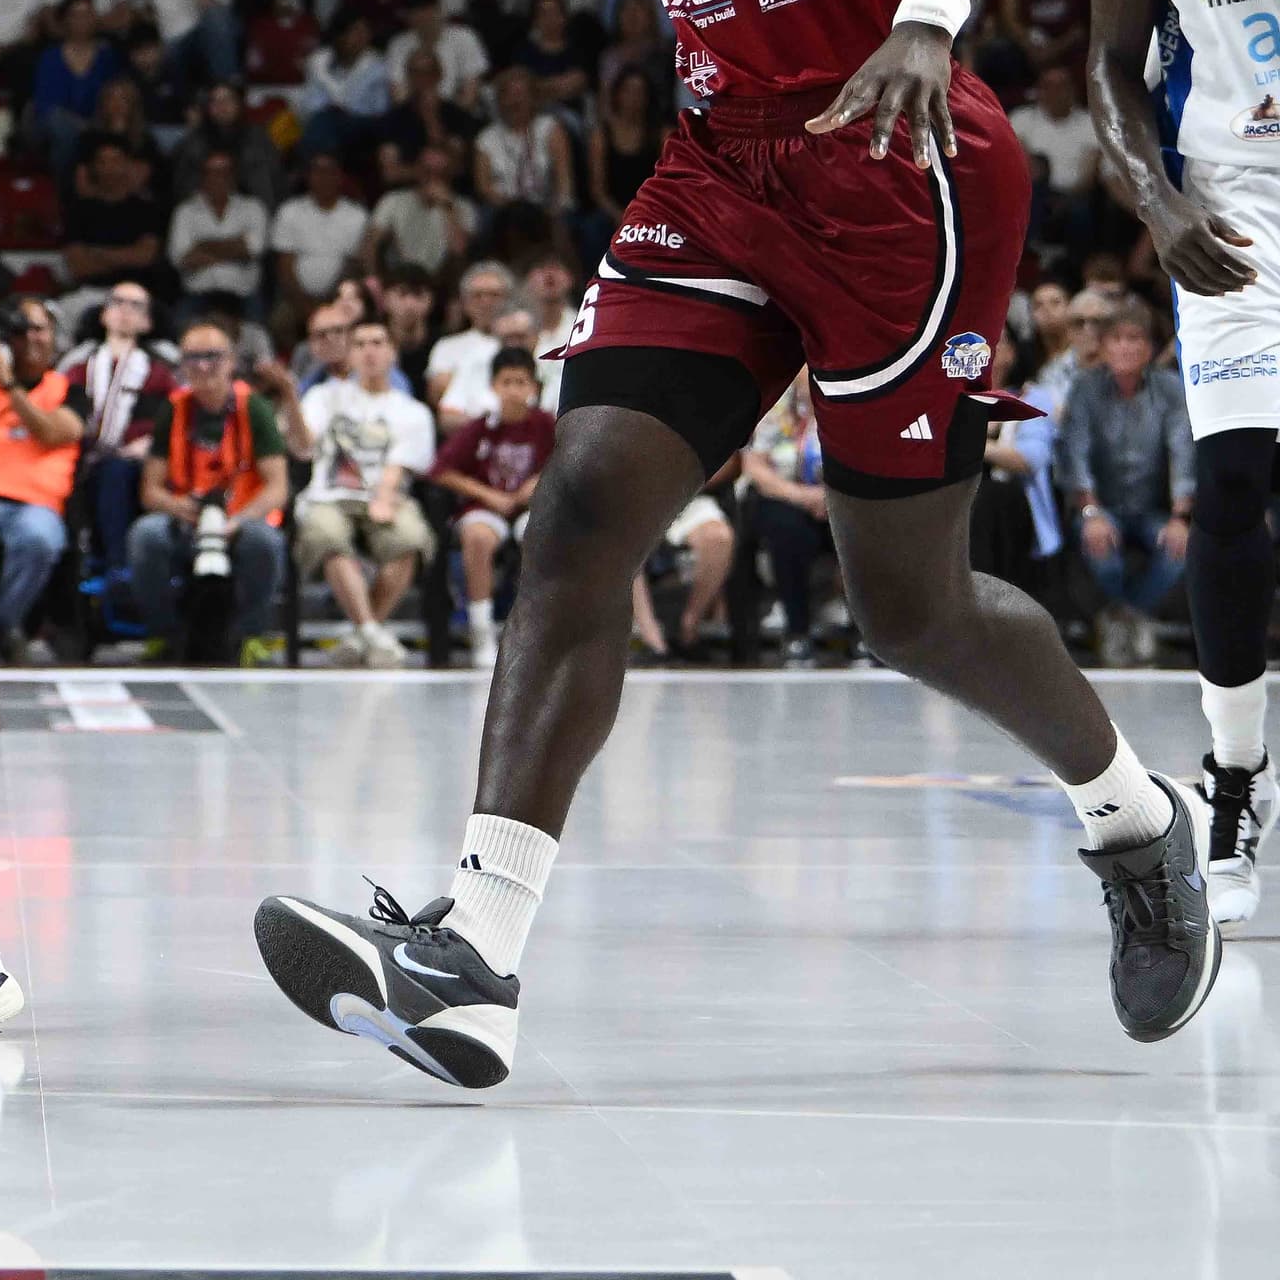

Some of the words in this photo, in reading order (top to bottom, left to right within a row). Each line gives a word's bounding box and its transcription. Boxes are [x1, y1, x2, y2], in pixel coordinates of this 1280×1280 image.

[714, 7, 737, 22] build
[1201, 354, 1277, 372] ZINCATURA
[1201, 366, 1278, 384] BRESCIANA
